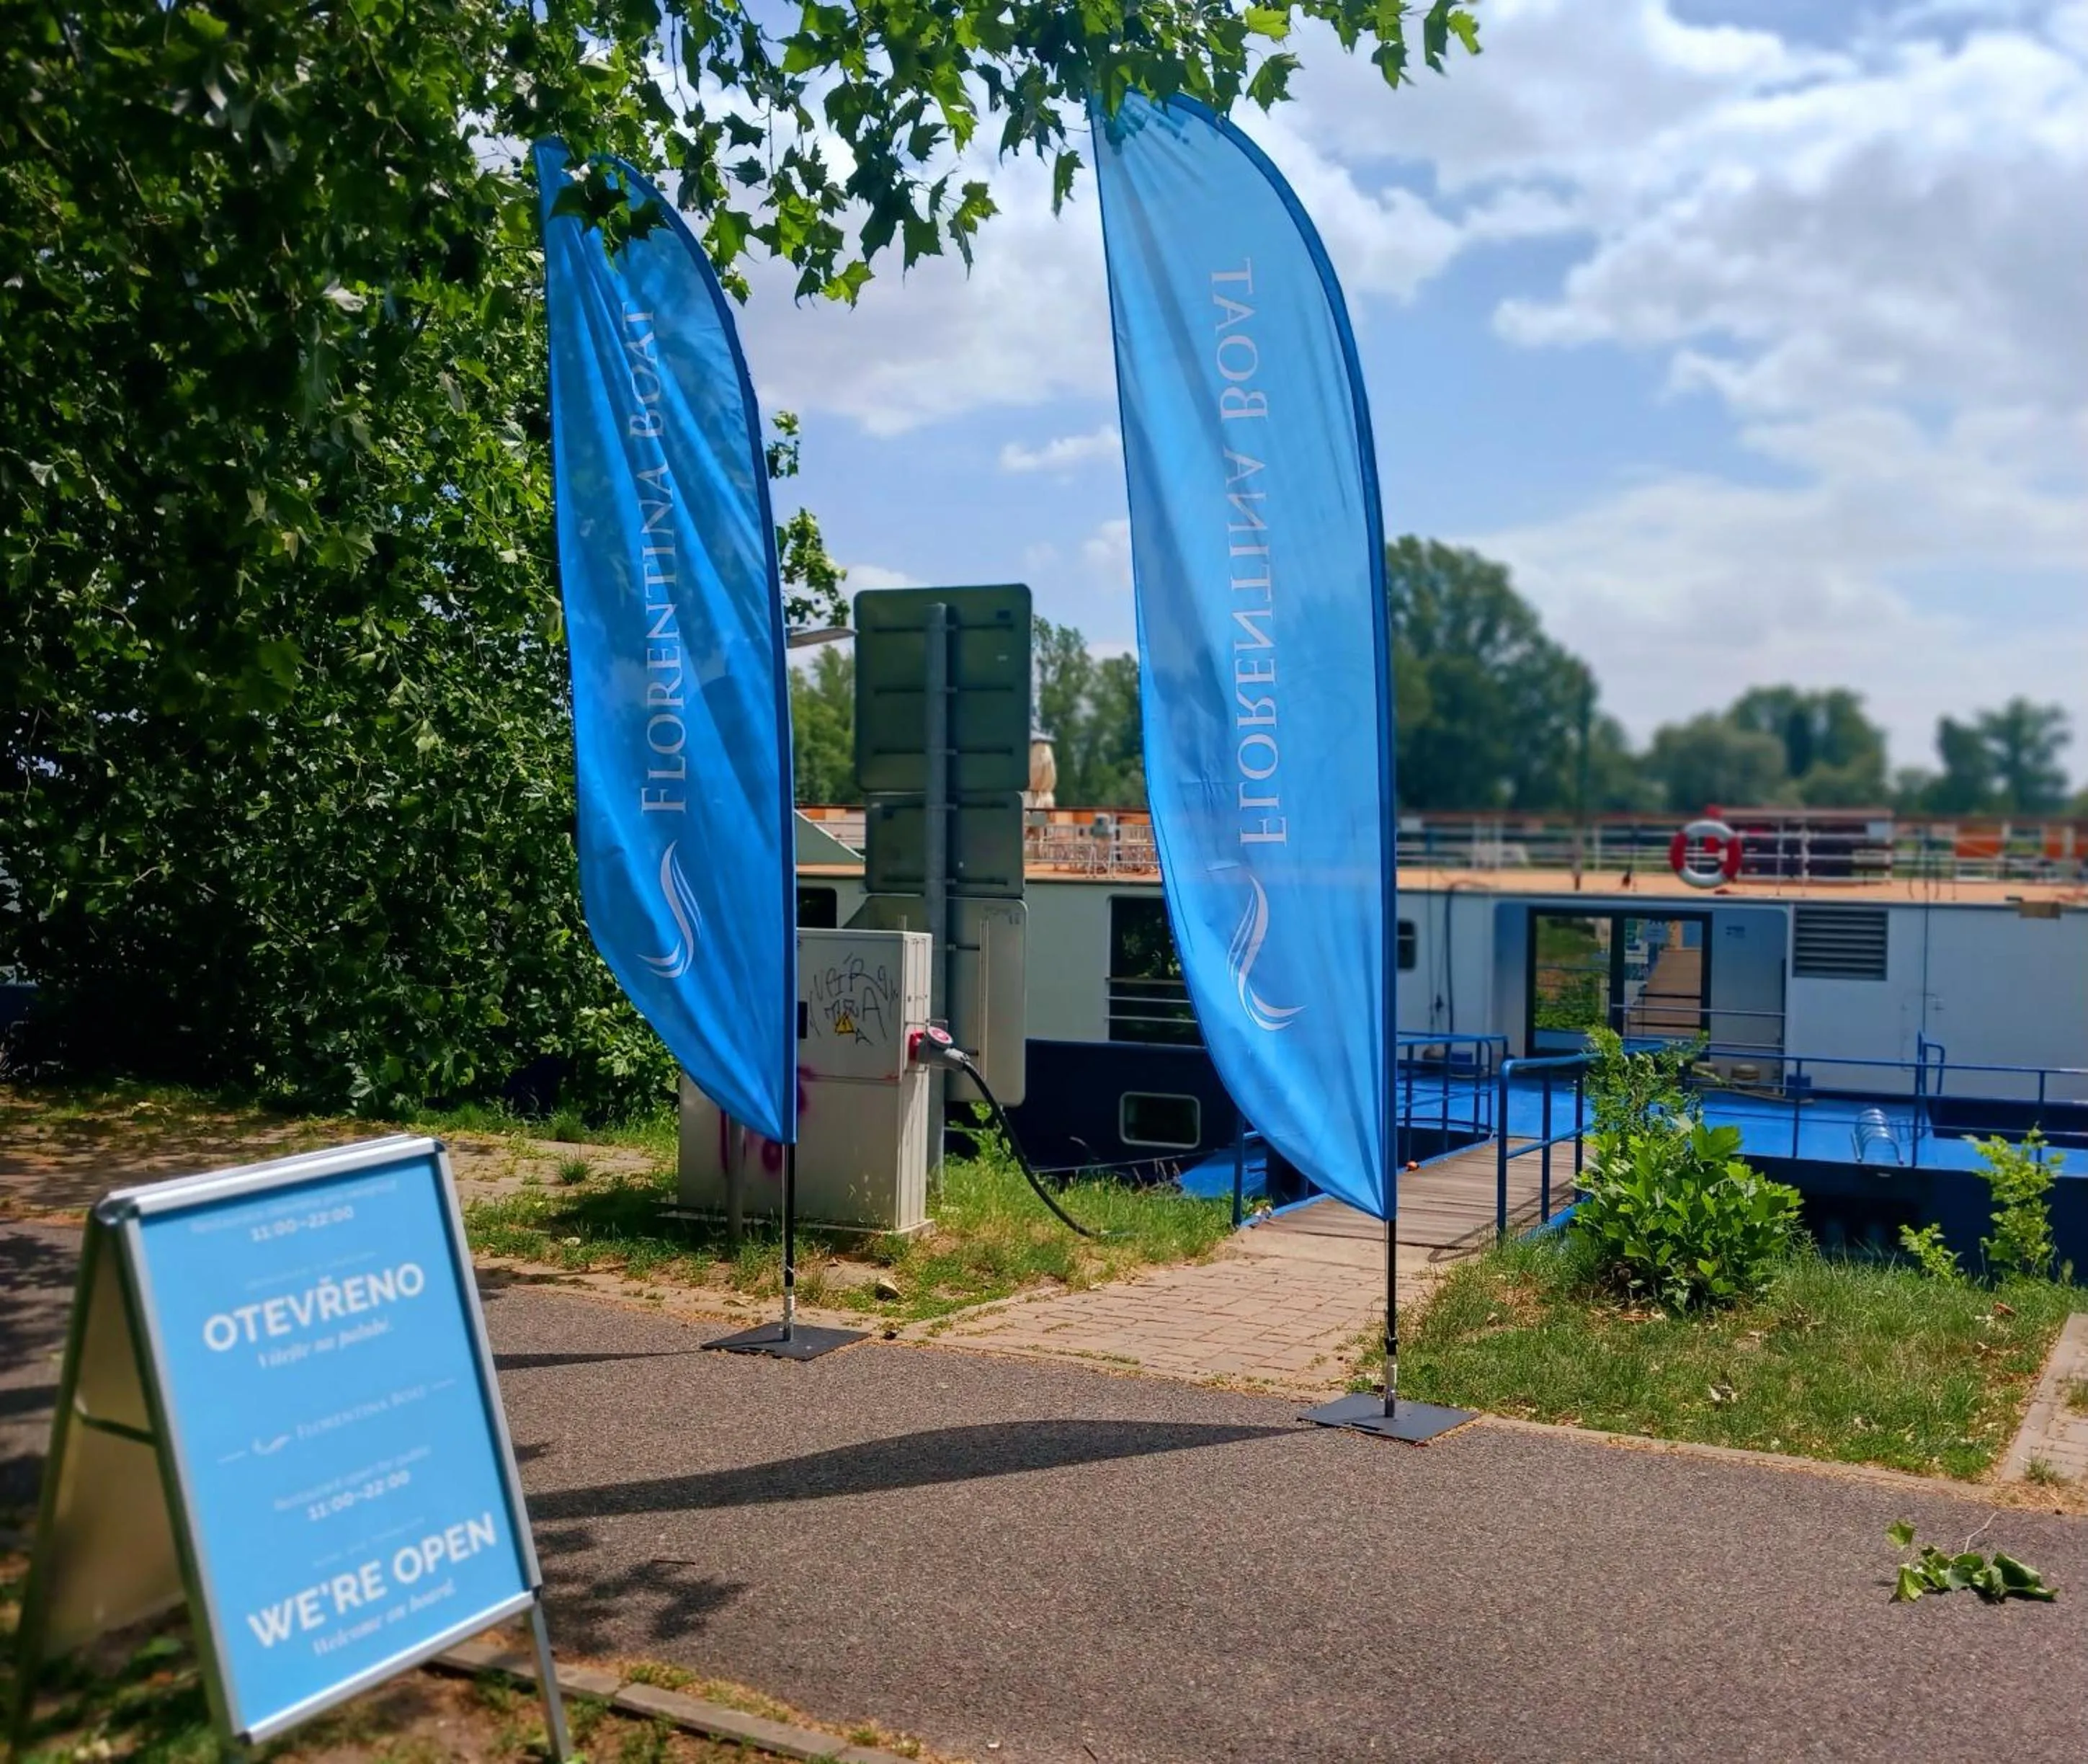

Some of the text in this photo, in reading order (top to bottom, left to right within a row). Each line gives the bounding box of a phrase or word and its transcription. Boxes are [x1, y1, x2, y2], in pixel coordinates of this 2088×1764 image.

[622, 301, 687, 814] FLORENTINA BOAT
[203, 1262, 424, 1351] OTEVŘENO
[247, 1560, 387, 1648] WE'RE
[393, 1512, 496, 1584] OPEN
